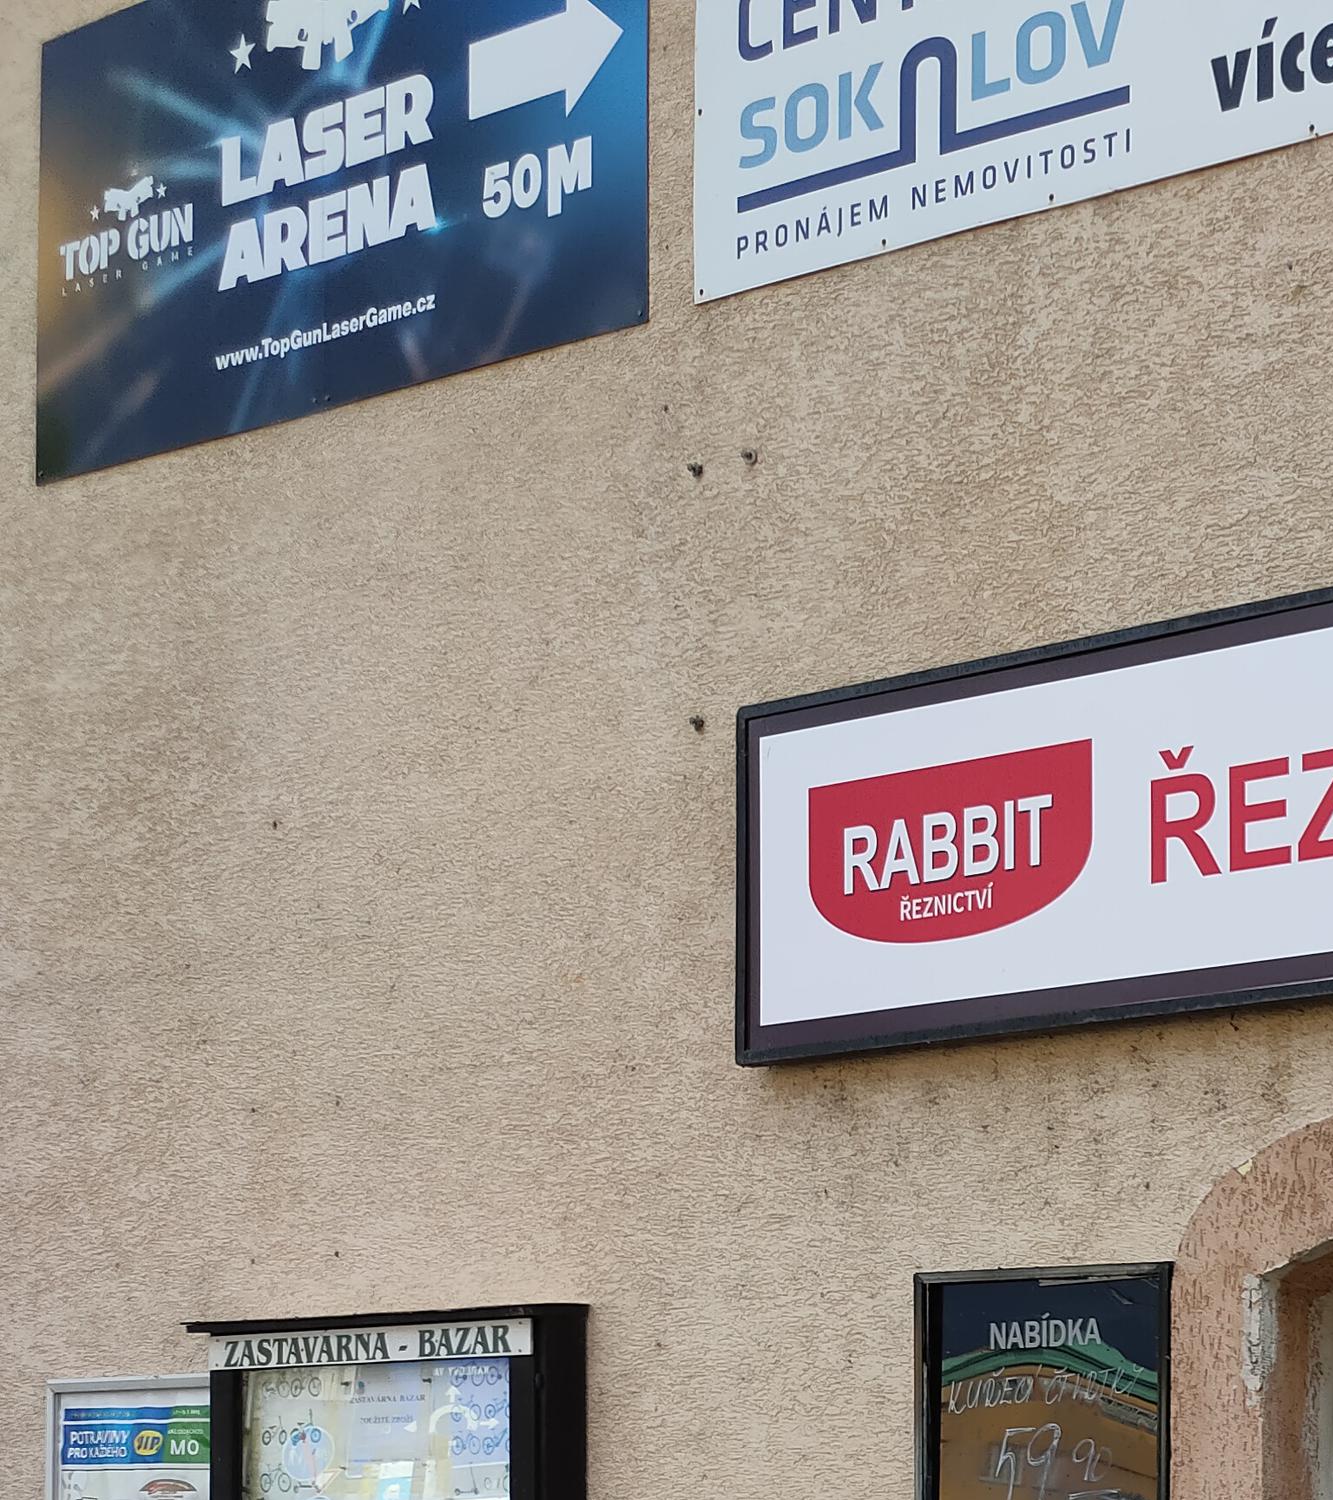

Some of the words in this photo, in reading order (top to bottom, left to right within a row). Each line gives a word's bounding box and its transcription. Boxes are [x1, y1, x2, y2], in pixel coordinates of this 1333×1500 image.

[221, 74, 434, 207] LASER
[217, 163, 438, 292] ARENA
[736, 195, 890, 260] PRONÁJEM
[911, 128, 1132, 210] NEMOVITOSTI
[59, 228, 121, 281] TOP
[127, 202, 194, 261] GUN
[61, 268, 123, 298] LASER
[141, 245, 194, 271] GAME
[215, 294, 436, 371] www.TopGunLaserGame.cz
[843, 793, 1054, 896] RABBIT
[900, 881, 994, 922] ŘEZNICTVÍ
[418, 1325, 513, 1358] BAZAR
[990, 1312, 1102, 1350] NABÍDKA
[67, 1447, 88, 1459] PRO
